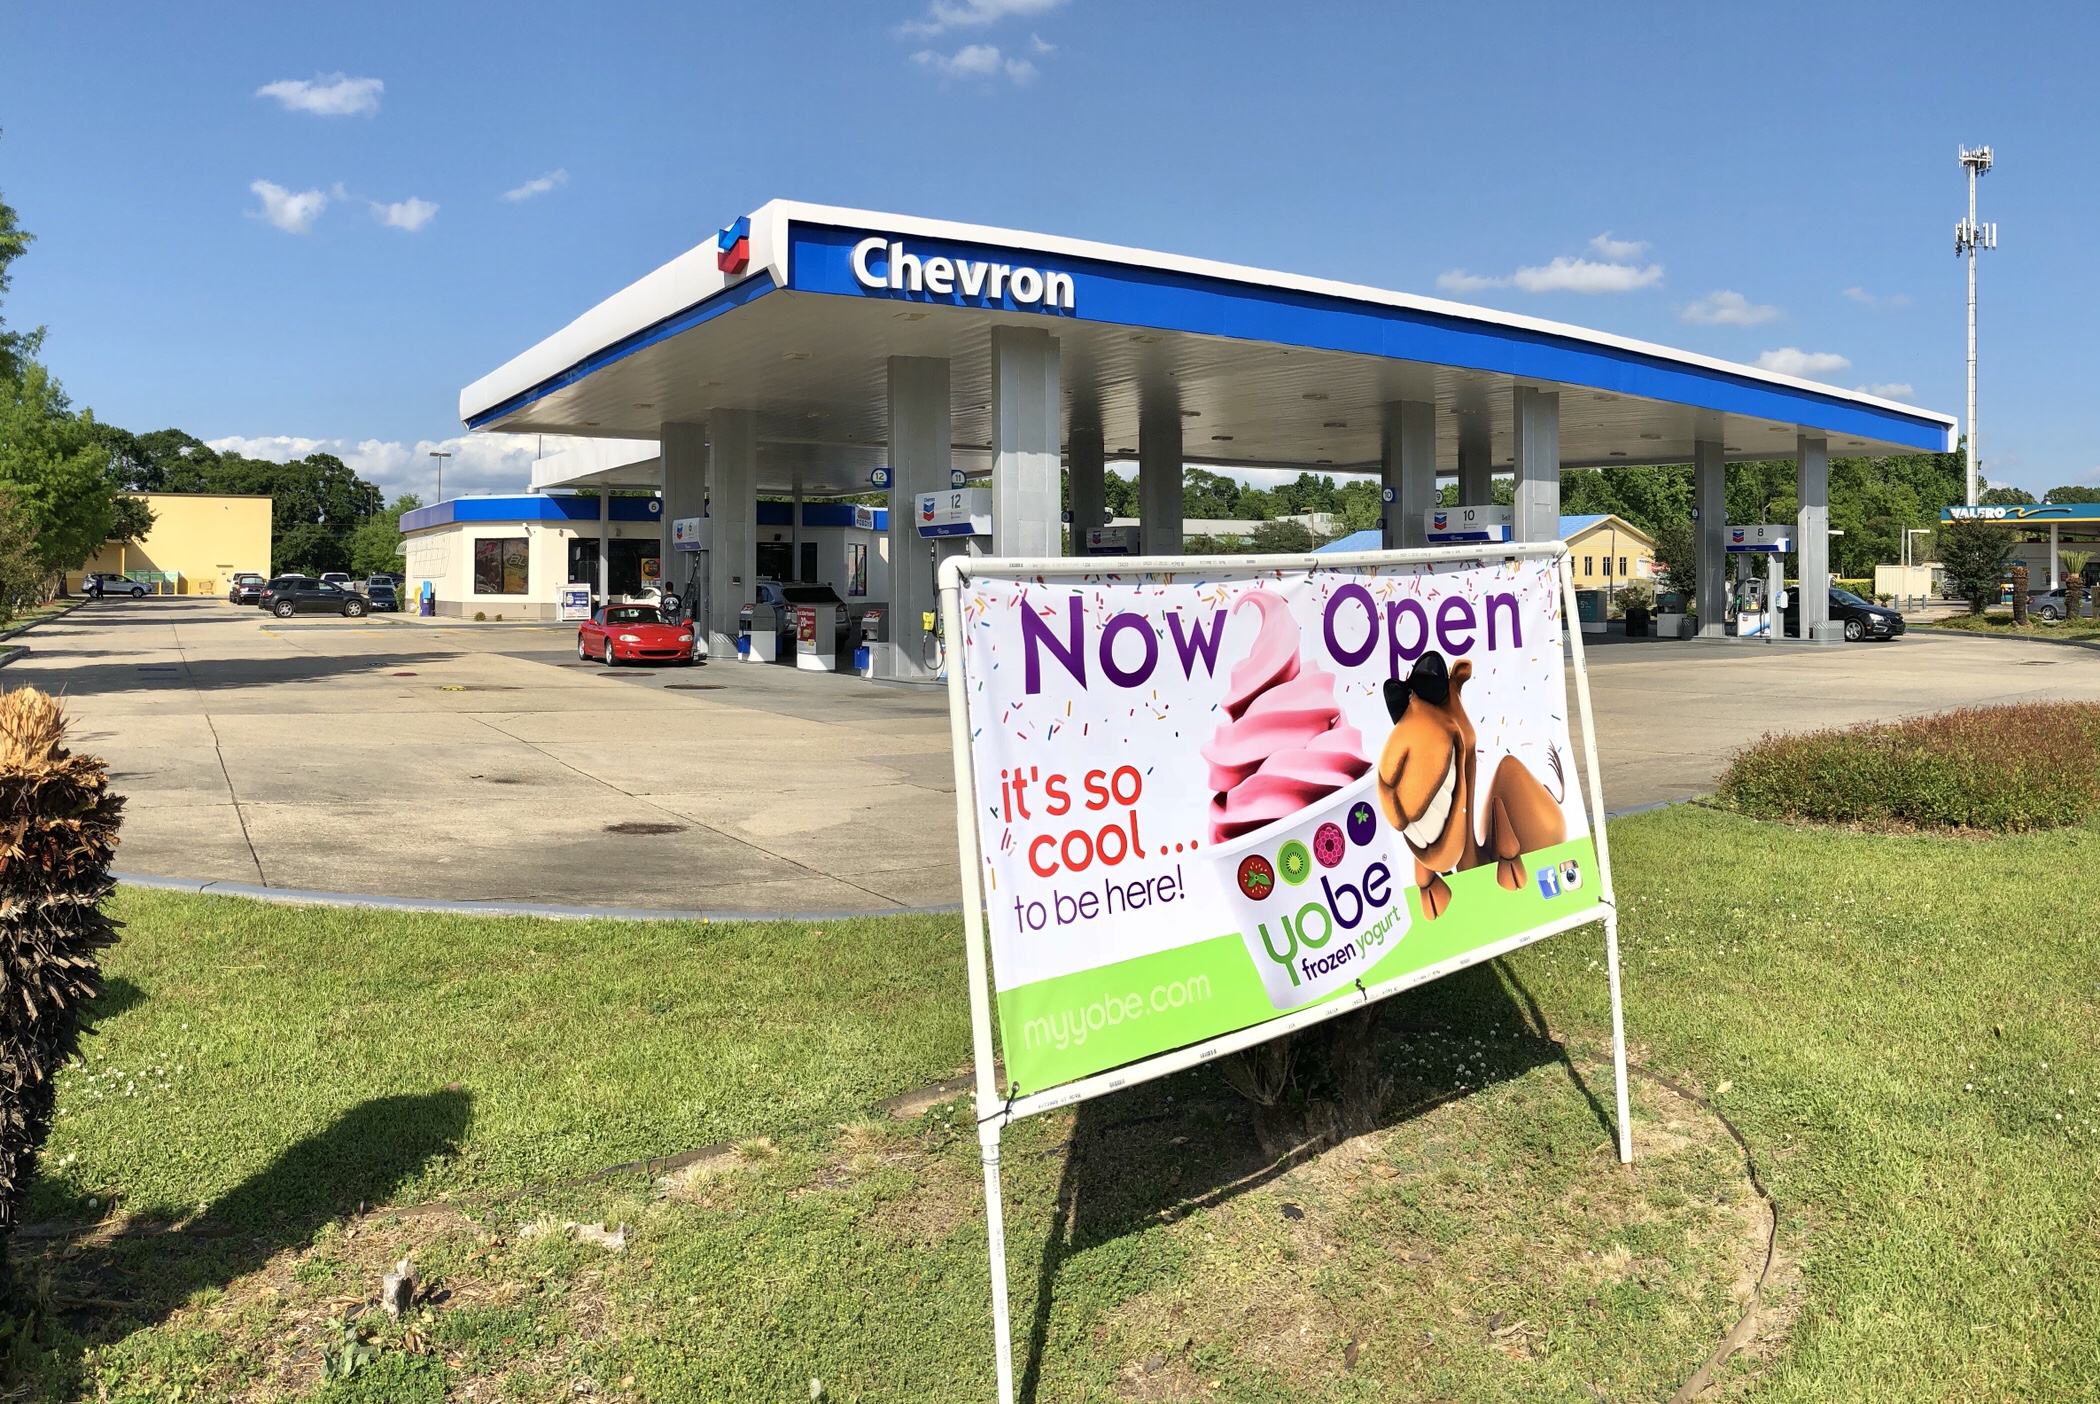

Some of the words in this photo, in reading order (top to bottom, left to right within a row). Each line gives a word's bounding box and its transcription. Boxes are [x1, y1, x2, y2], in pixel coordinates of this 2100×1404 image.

[852, 236, 1076, 309] Chevron
[951, 493, 961, 509] 12
[1463, 509, 1475, 521] 10
[1757, 527, 1764, 537] 8
[1950, 507, 2007, 519] VALERO
[1020, 595, 1228, 695] Now
[1323, 583, 1523, 680] Open
[1001, 766, 1071, 823] it's
[1083, 765, 1143, 811] so
[1014, 895, 1047, 934] to
[1053, 889, 1100, 926] be
[1105, 863, 1186, 915] here!
[1301, 942, 1357, 981] frozen
[1354, 905, 1401, 960] yogurt
[1023, 973, 1212, 1051] myyobe.com
